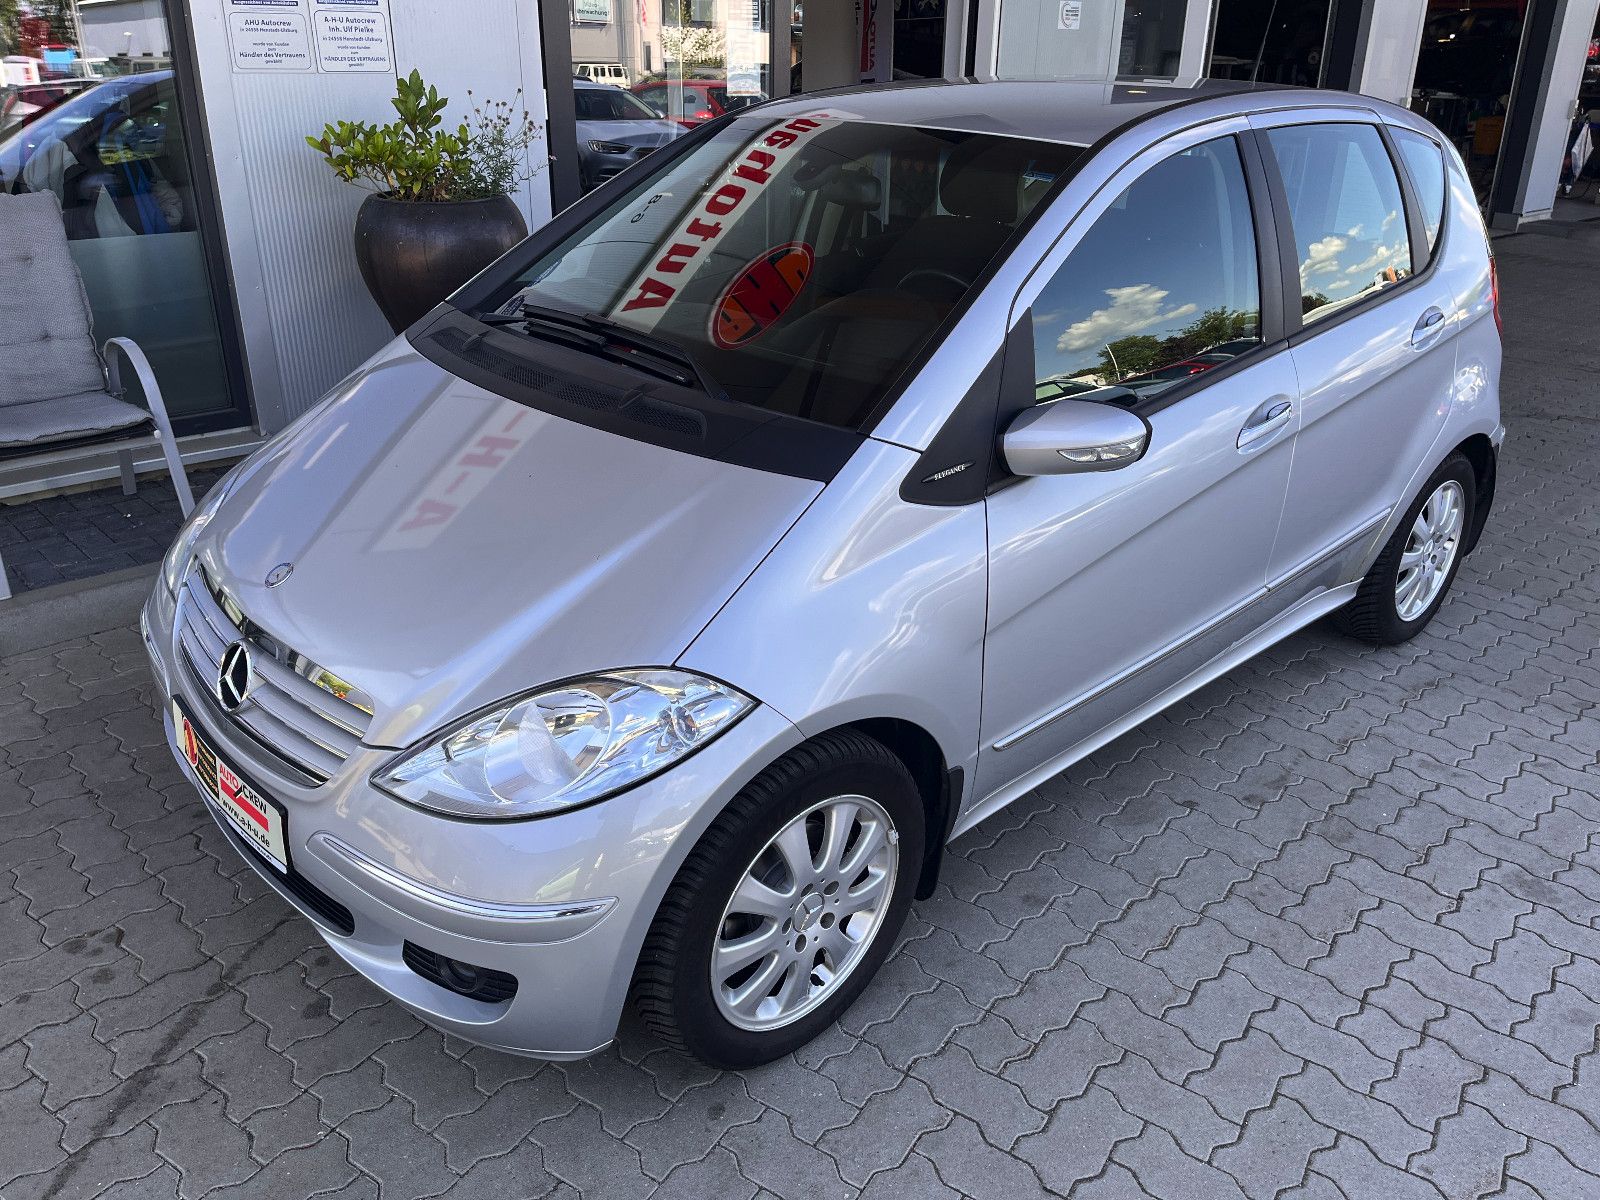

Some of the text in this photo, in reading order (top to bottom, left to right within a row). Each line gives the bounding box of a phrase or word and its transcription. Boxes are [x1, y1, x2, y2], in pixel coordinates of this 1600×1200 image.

[324, 16, 344, 24] A-H-U
[934, 463, 966, 481] ELEGANCE
[221, 797, 271, 848] www.a-h-u.de
